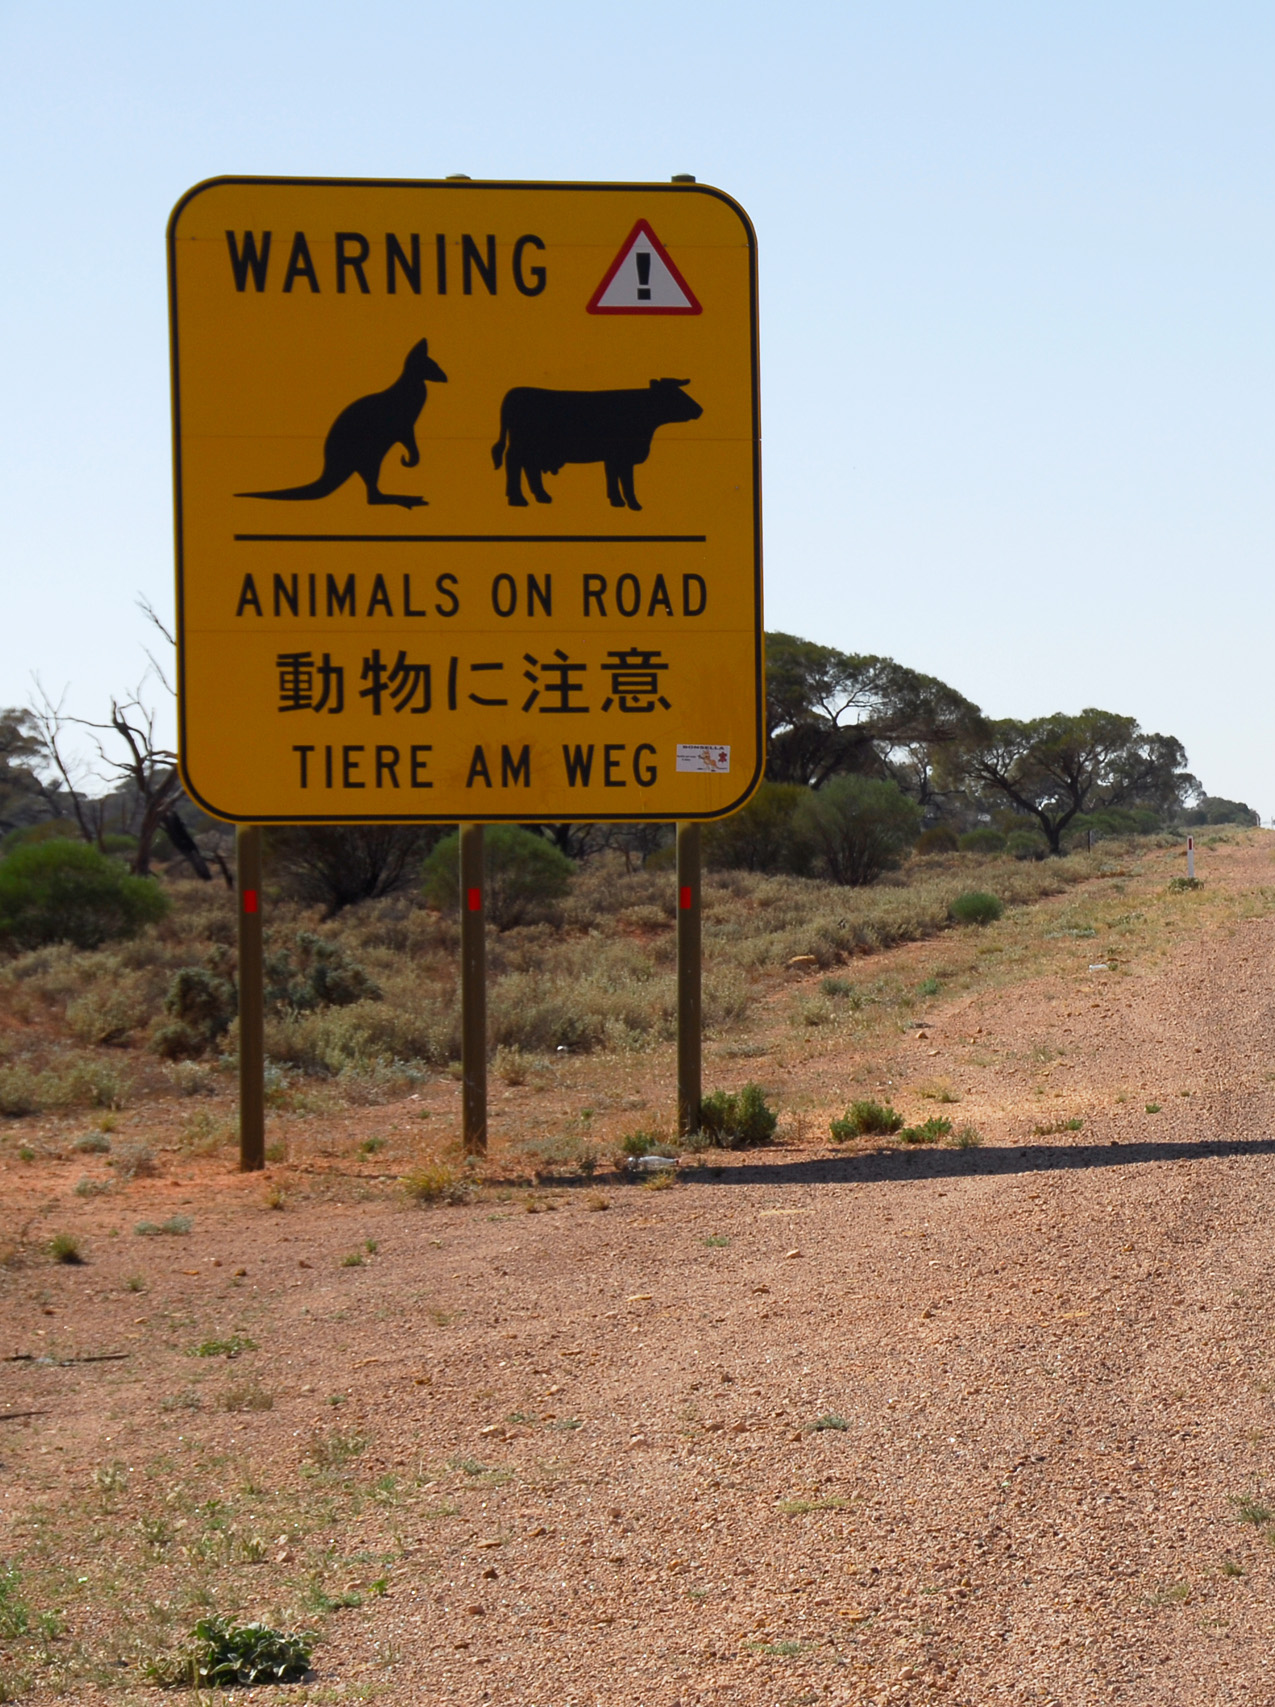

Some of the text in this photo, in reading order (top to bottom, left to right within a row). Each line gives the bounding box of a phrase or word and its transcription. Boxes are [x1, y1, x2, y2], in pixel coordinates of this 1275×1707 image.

[226, 231, 547, 297] WARNING
[236, 573, 708, 618] ANIMALS ON ROAD
[275, 646, 672, 716] 動物に注意
[292, 743, 657, 789] TIERE AM WEG
